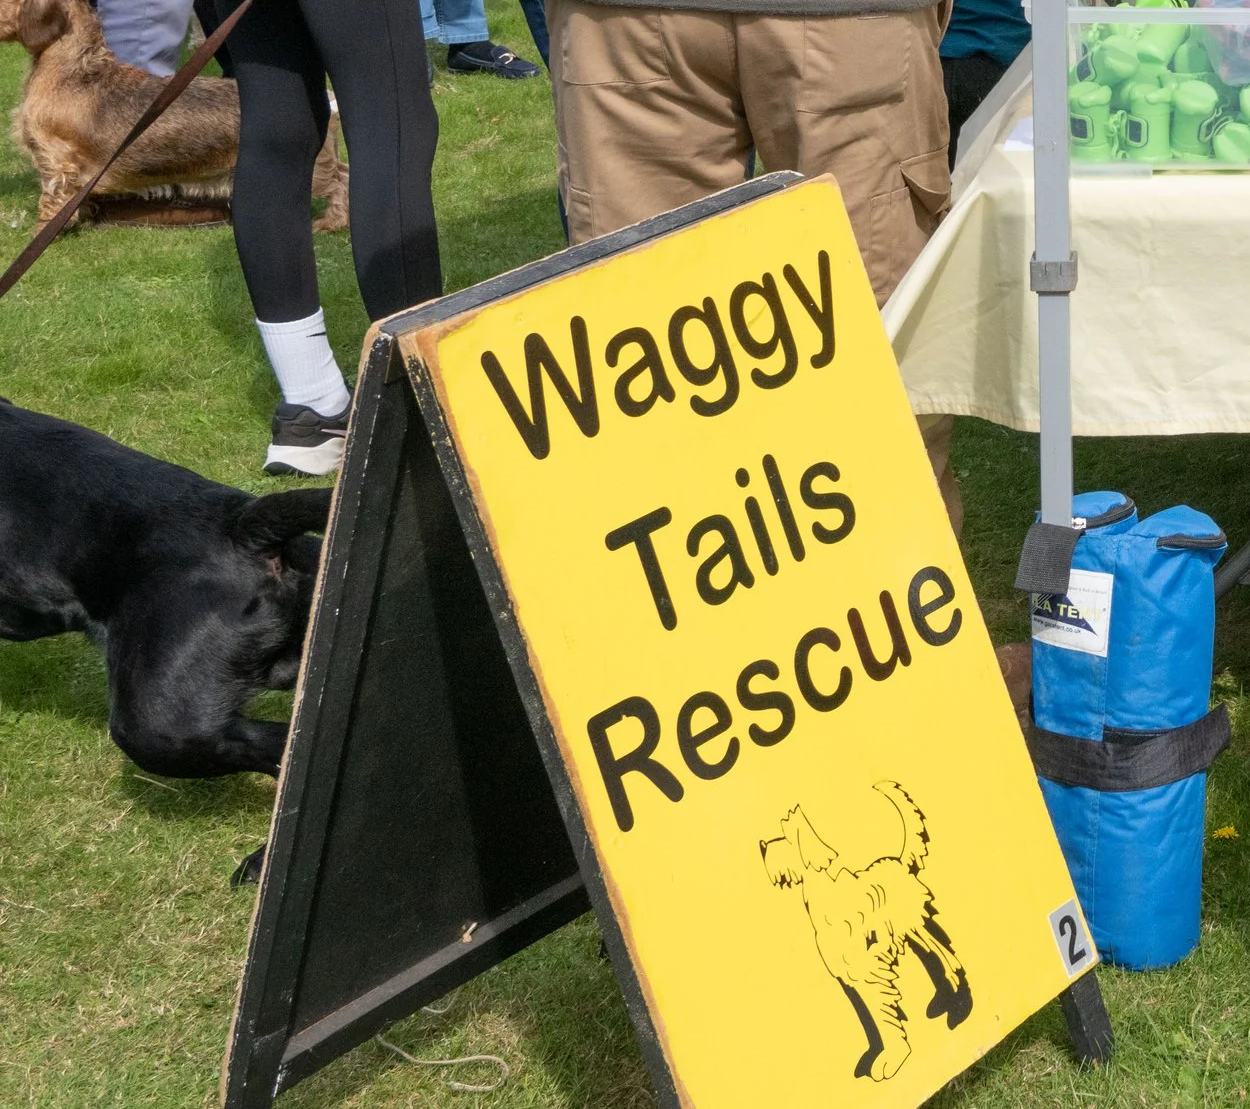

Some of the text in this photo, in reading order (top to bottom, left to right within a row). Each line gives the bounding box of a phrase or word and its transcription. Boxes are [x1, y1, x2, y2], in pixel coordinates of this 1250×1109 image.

[480, 250, 836, 460] Waggy
[605, 454, 856, 631] Tails
[586, 565, 963, 833] Rescue
[1058, 914, 1086, 966] 2
